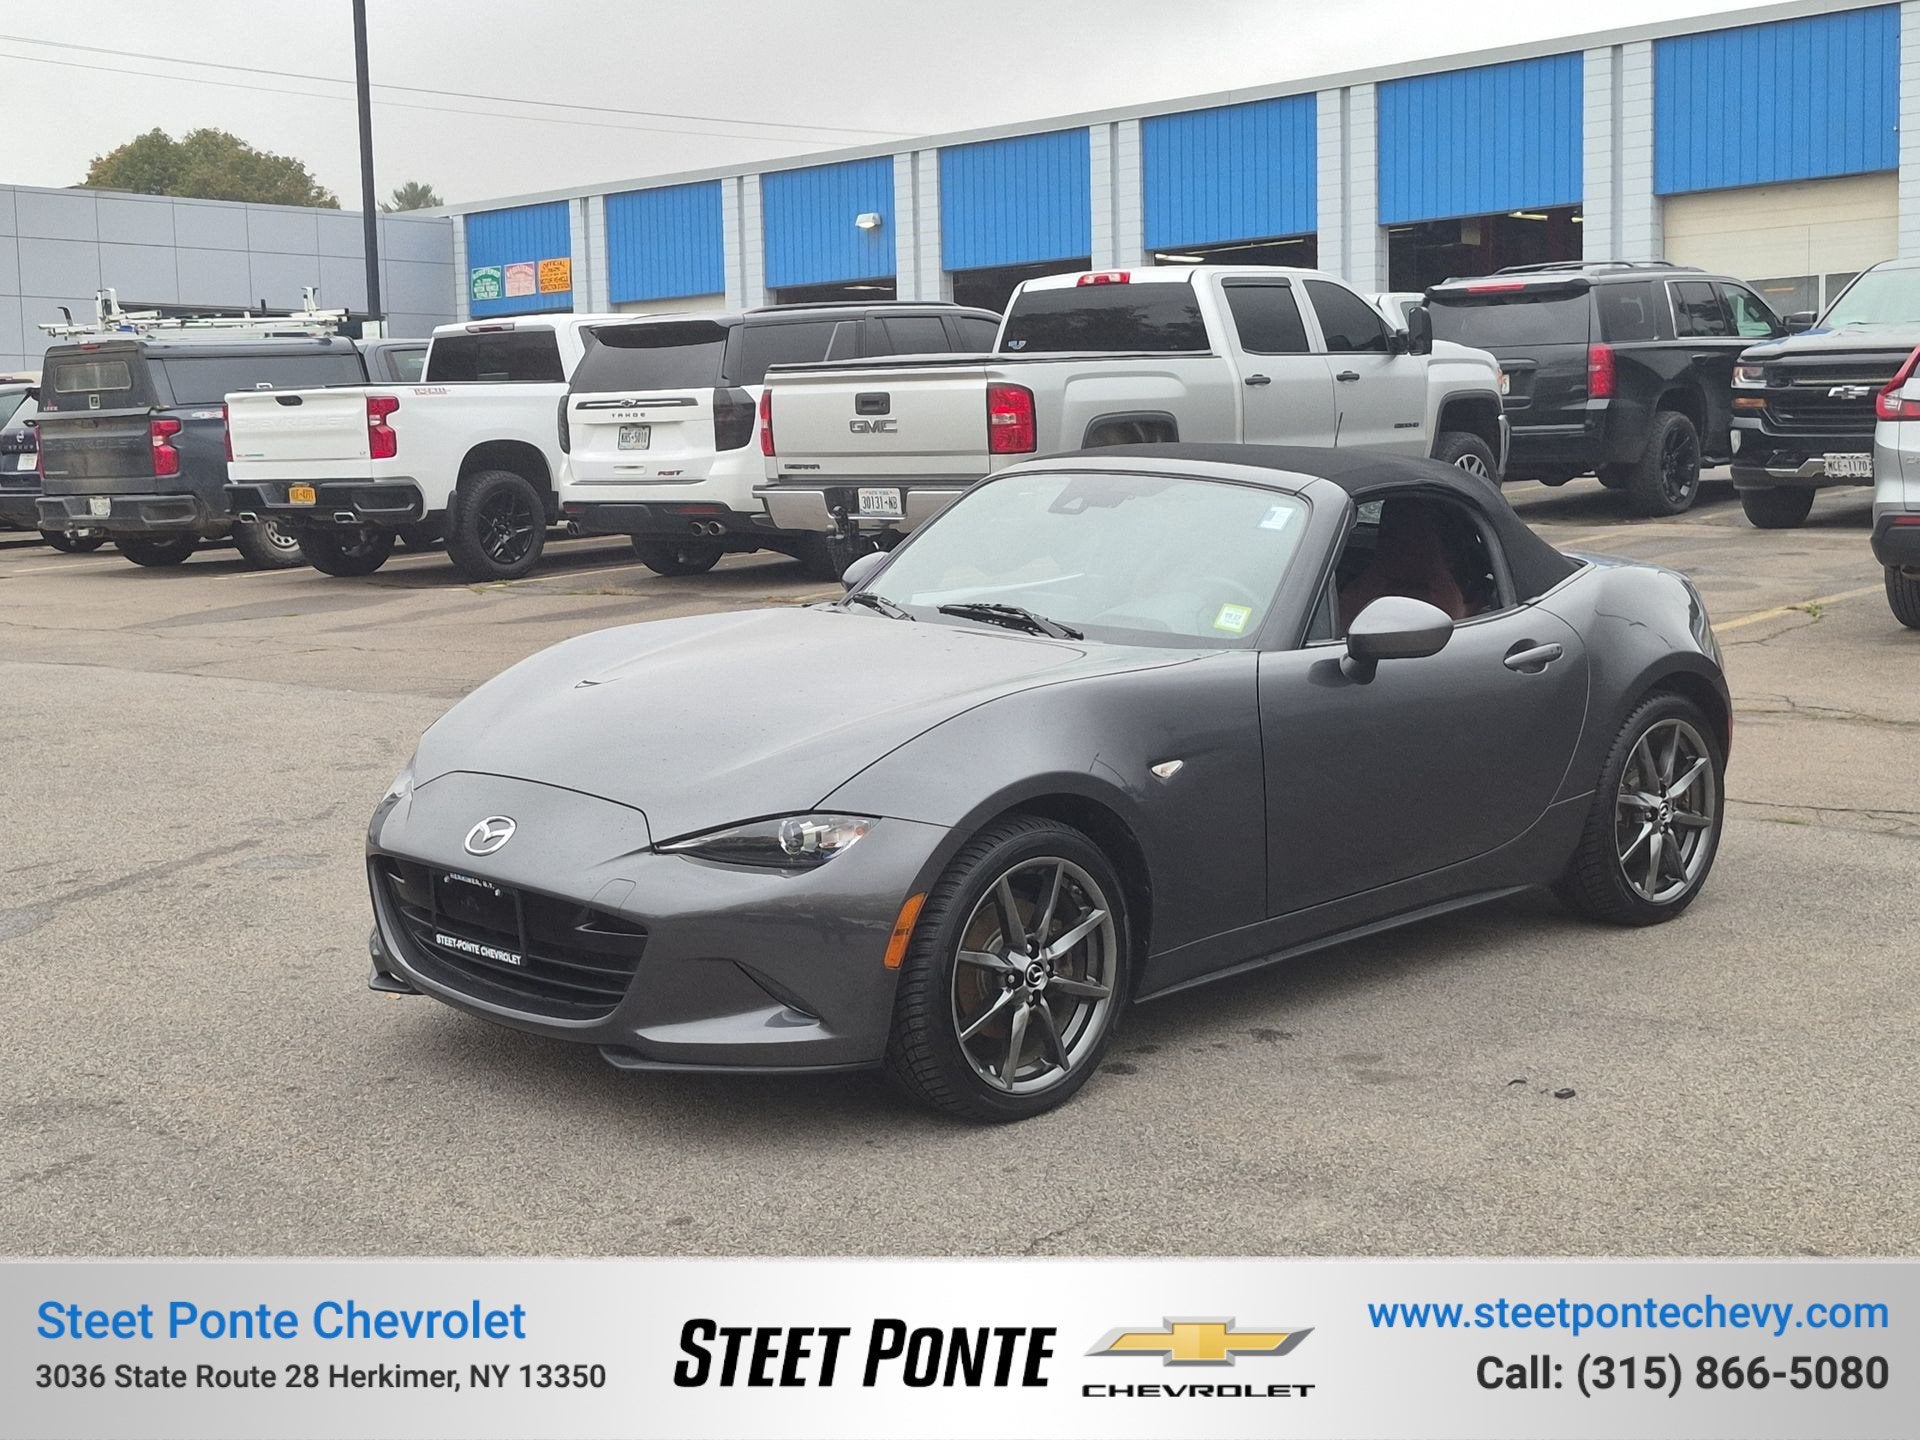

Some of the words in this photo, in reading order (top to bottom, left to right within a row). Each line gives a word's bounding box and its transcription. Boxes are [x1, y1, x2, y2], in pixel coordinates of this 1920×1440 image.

[850, 419, 898, 433] GMC
[435, 933, 480, 955] STEET-PONTE
[480, 945, 522, 966] CHEVROLET
